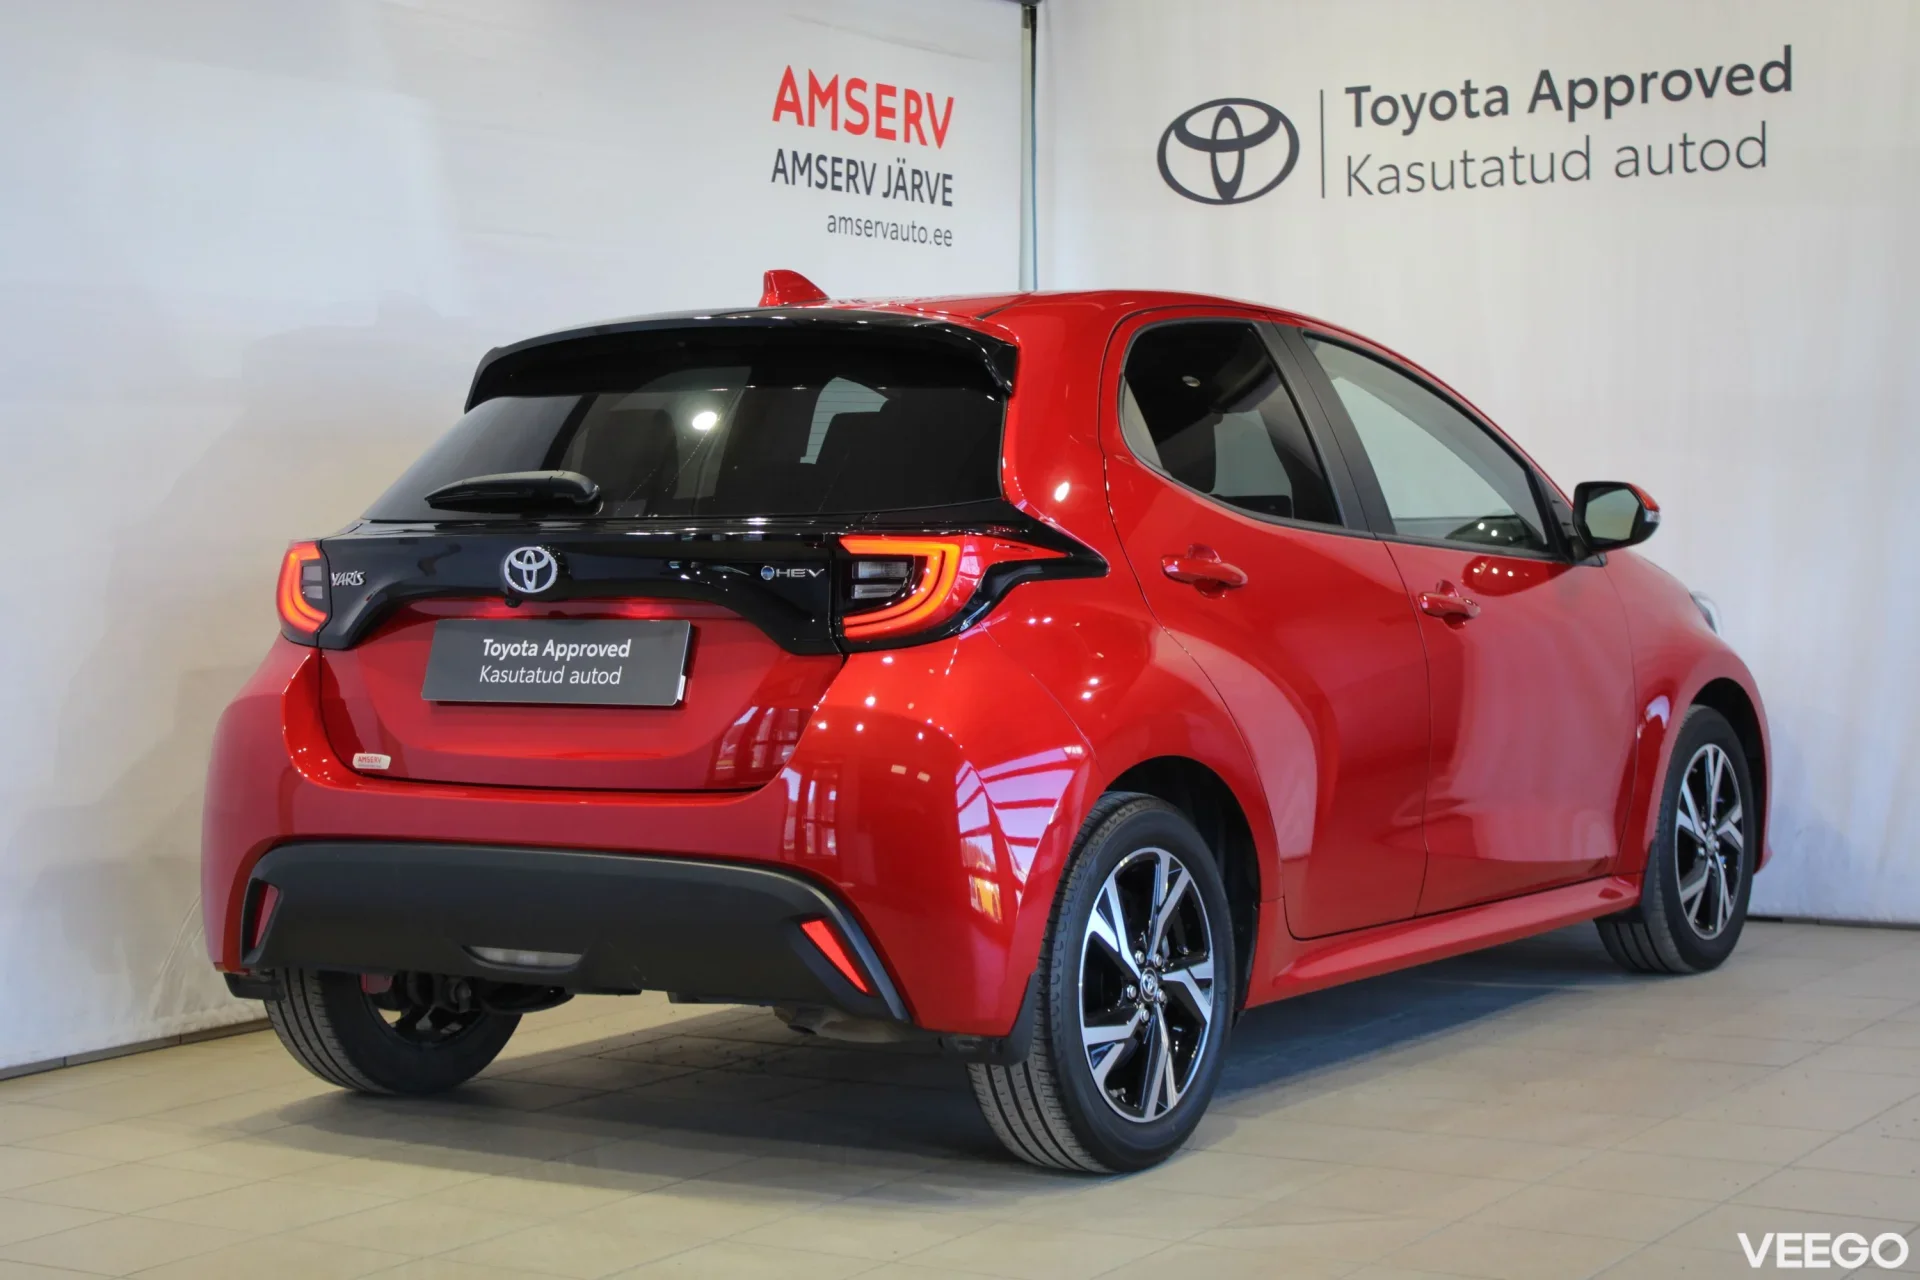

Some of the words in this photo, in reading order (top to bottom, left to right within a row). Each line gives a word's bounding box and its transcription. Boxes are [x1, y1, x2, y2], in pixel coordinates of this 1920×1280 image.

[772, 64, 954, 149] AMSERV
[1345, 79, 1509, 136] Toyota
[1527, 44, 1792, 123] Approved
[771, 148, 877, 196] AMSERV
[882, 157, 953, 207] JÄRVE
[1347, 134, 1590, 197] Kasutatud
[1614, 120, 1766, 178] autod
[827, 214, 953, 247] amservauto.ee
[775, 568, 825, 578] HEV
[483, 638, 539, 661] Toyota
[542, 638, 632, 662] Approved
[479, 665, 565, 684] Kasutatud
[569, 666, 622, 685] autod
